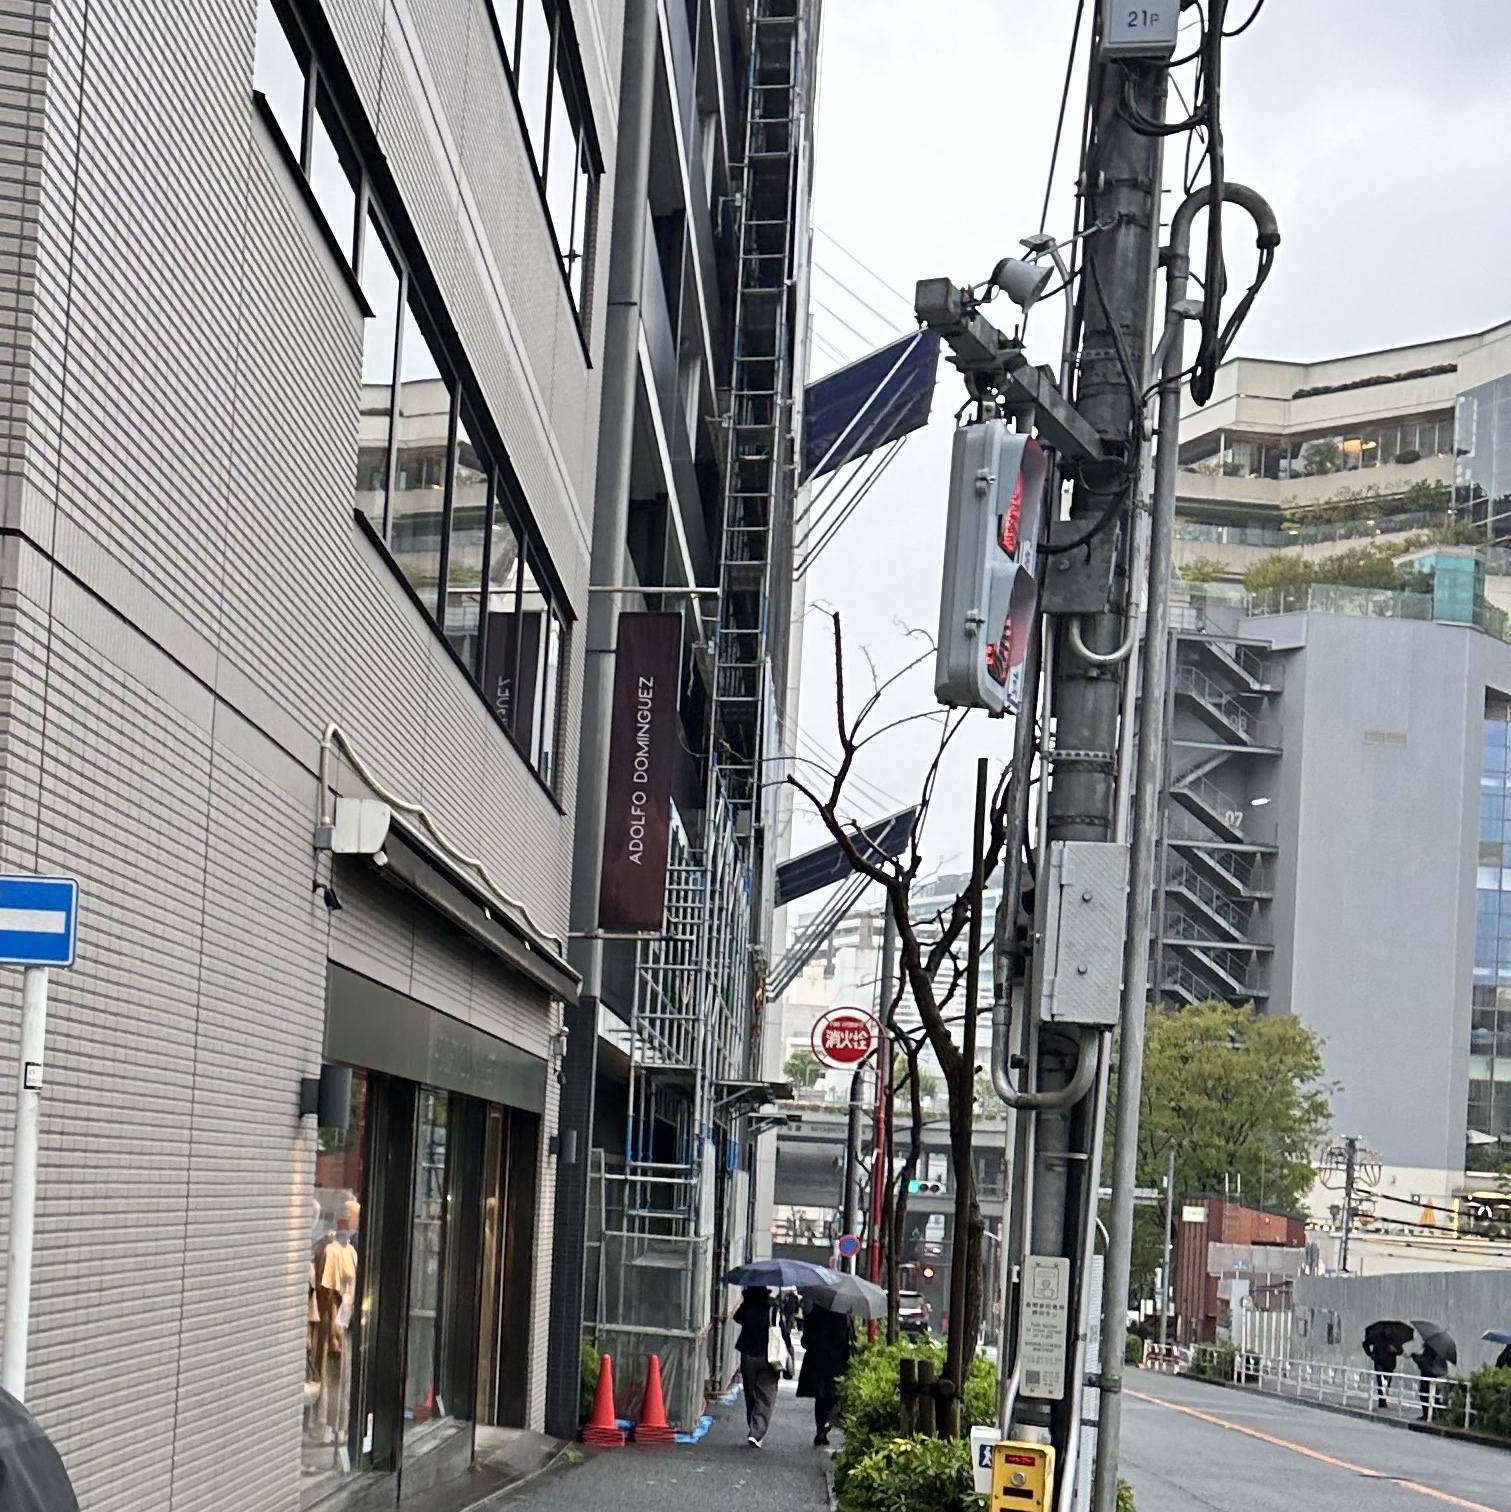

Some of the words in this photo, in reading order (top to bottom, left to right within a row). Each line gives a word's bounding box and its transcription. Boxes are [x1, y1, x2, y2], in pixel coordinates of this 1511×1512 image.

[633, 676, 654, 783] DOMINGUEZ
[629, 790, 647, 866] ADOLFO
[1225, 810, 1243, 827] 07
[825, 1029, 869, 1050] 消火栓
